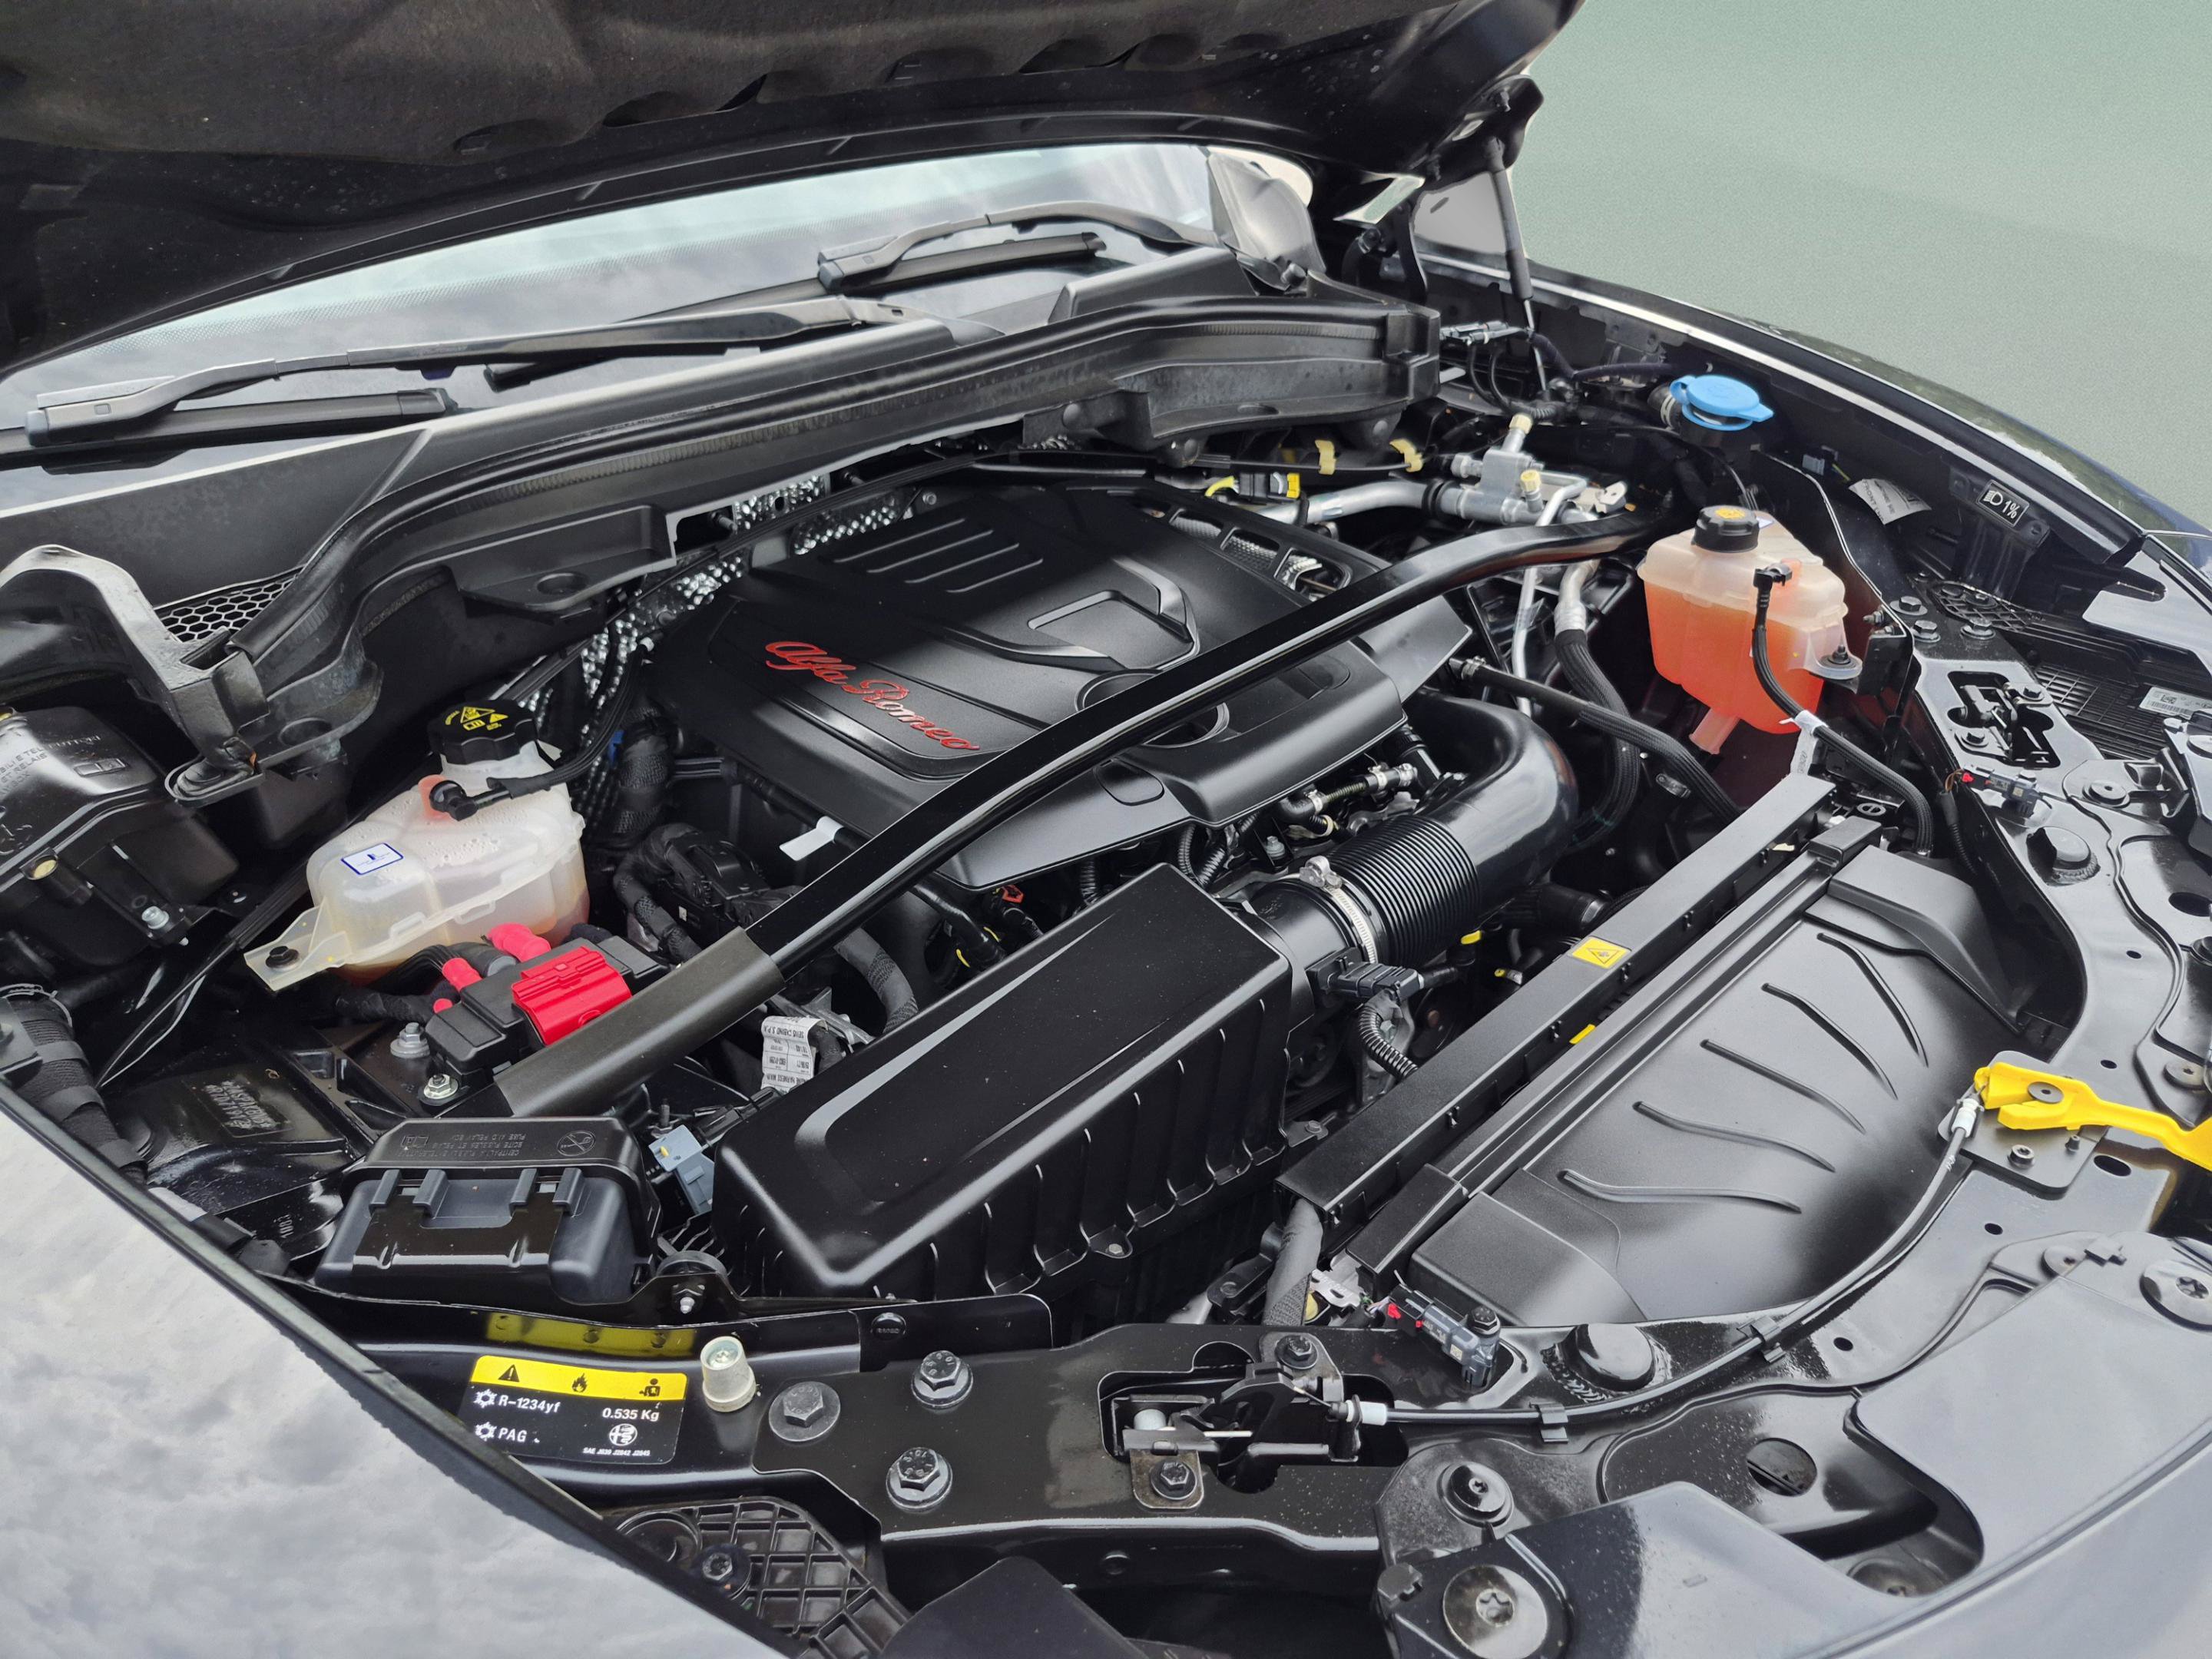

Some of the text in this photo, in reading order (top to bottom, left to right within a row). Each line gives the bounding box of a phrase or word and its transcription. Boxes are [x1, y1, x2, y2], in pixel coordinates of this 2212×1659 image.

[2002, 499, 2021, 519] 1%
[765, 640, 981, 750] Alfa Romeo
[498, 1395, 561, 1415] R-1234yf
[602, 1407, 660, 1422] 0.535 Kg
[498, 1427, 528, 1442] PAG
